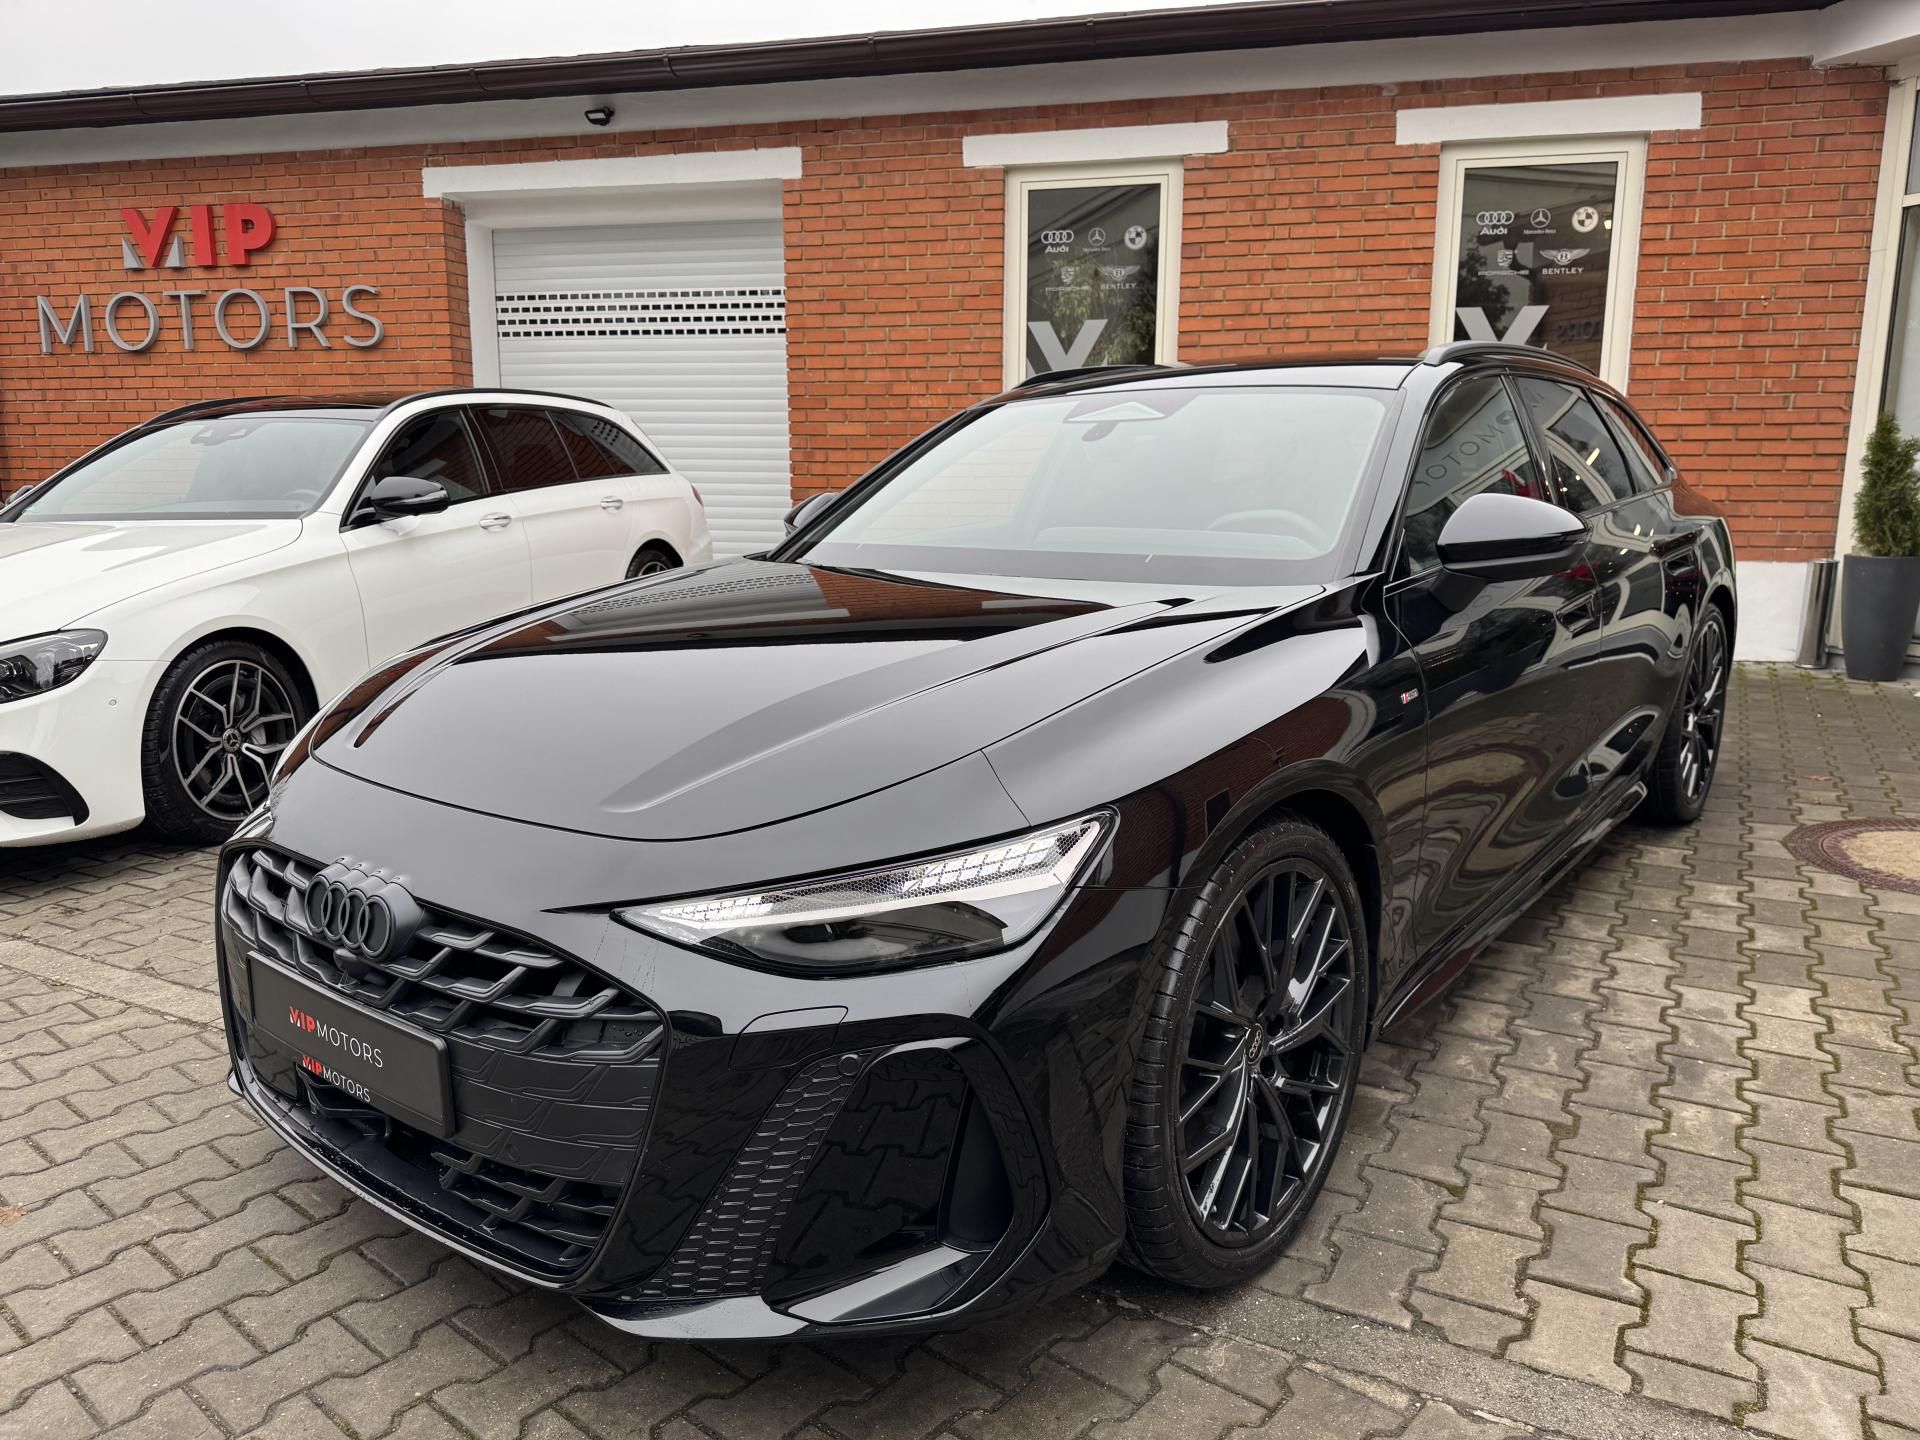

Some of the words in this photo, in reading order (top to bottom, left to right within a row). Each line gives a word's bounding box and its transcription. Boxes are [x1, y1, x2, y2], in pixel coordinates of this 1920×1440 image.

[1480, 226, 1508, 236] Audi
[120, 203, 277, 270] VIP
[1542, 266, 1584, 276] BENTLEY
[1100, 282, 1138, 291] BENTLEY
[36, 284, 385, 355] MOTORS
